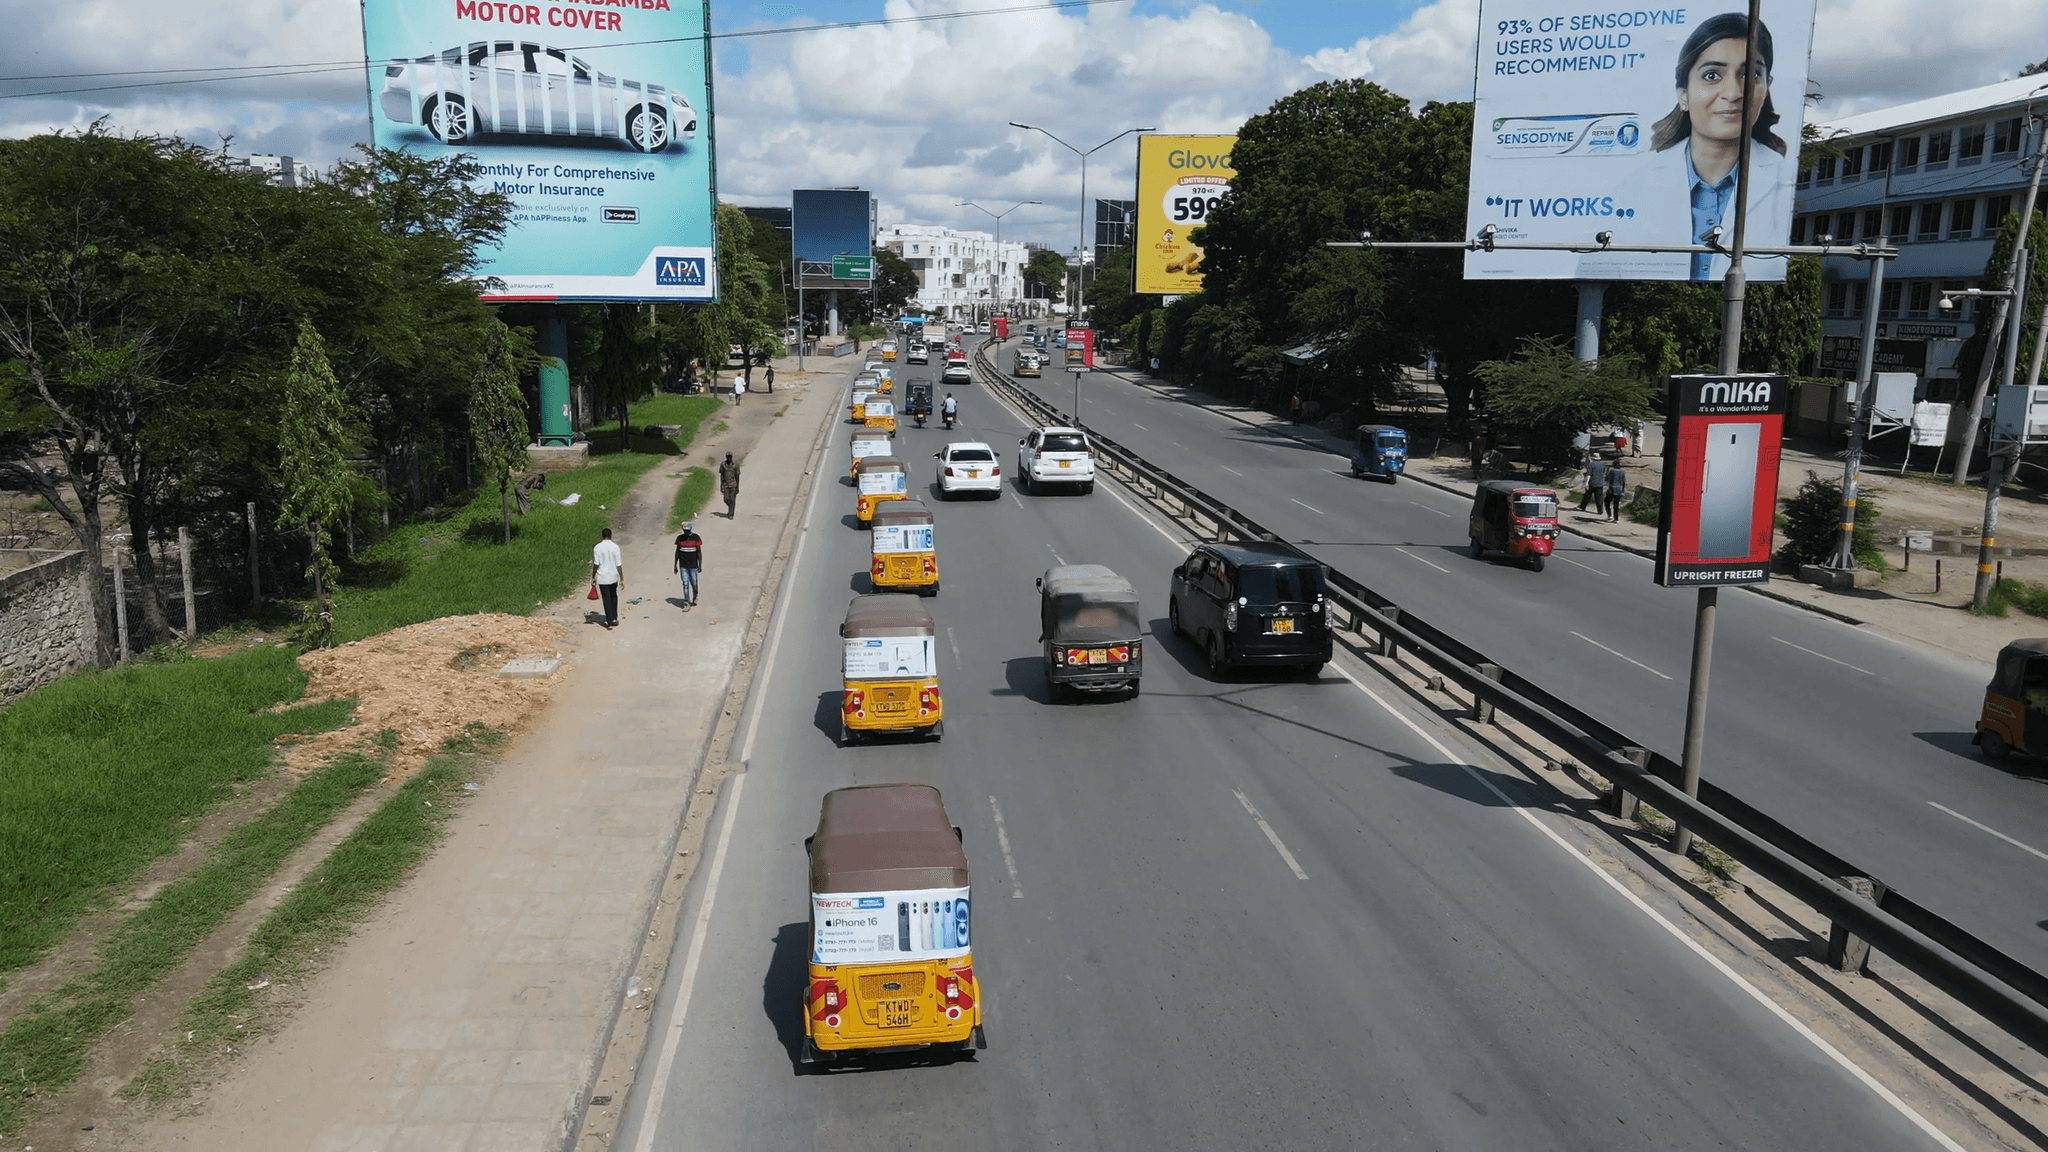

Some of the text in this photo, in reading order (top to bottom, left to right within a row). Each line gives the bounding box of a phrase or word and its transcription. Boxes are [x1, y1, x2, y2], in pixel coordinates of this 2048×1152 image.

[456, 0, 541, 25] MOTOR
[548, 7, 622, 32] COVER
[1497, 9, 1687, 35] 93% OF SENSODYNE
[1496, 33, 1632, 56] USERS WOULD
[1495, 54, 1617, 76] RECOMMEND
[1496, 132, 1575, 145] SENSODYNE
[527, 164, 550, 177] For
[554, 165, 656, 182] Comprehensive
[494, 181, 605, 197] Motor Insurance
[535, 204, 578, 213] exclusively
[531, 214, 571, 222] hAPPiness
[659, 260, 702, 278] APA
[1898, 325, 1955, 335] KINDERGARTEN
[1873, 352, 1905, 365] CADEMY
[1700, 381, 1771, 404] MIKA
[1673, 569, 1764, 580] UPRIGHT FREEZER
[816, 900, 852, 908] NEWTECH
[832, 917, 878, 927] iPhone 16
[885, 1000, 909, 1013] KTWD
[886, 1013, 909, 1026] 546H
